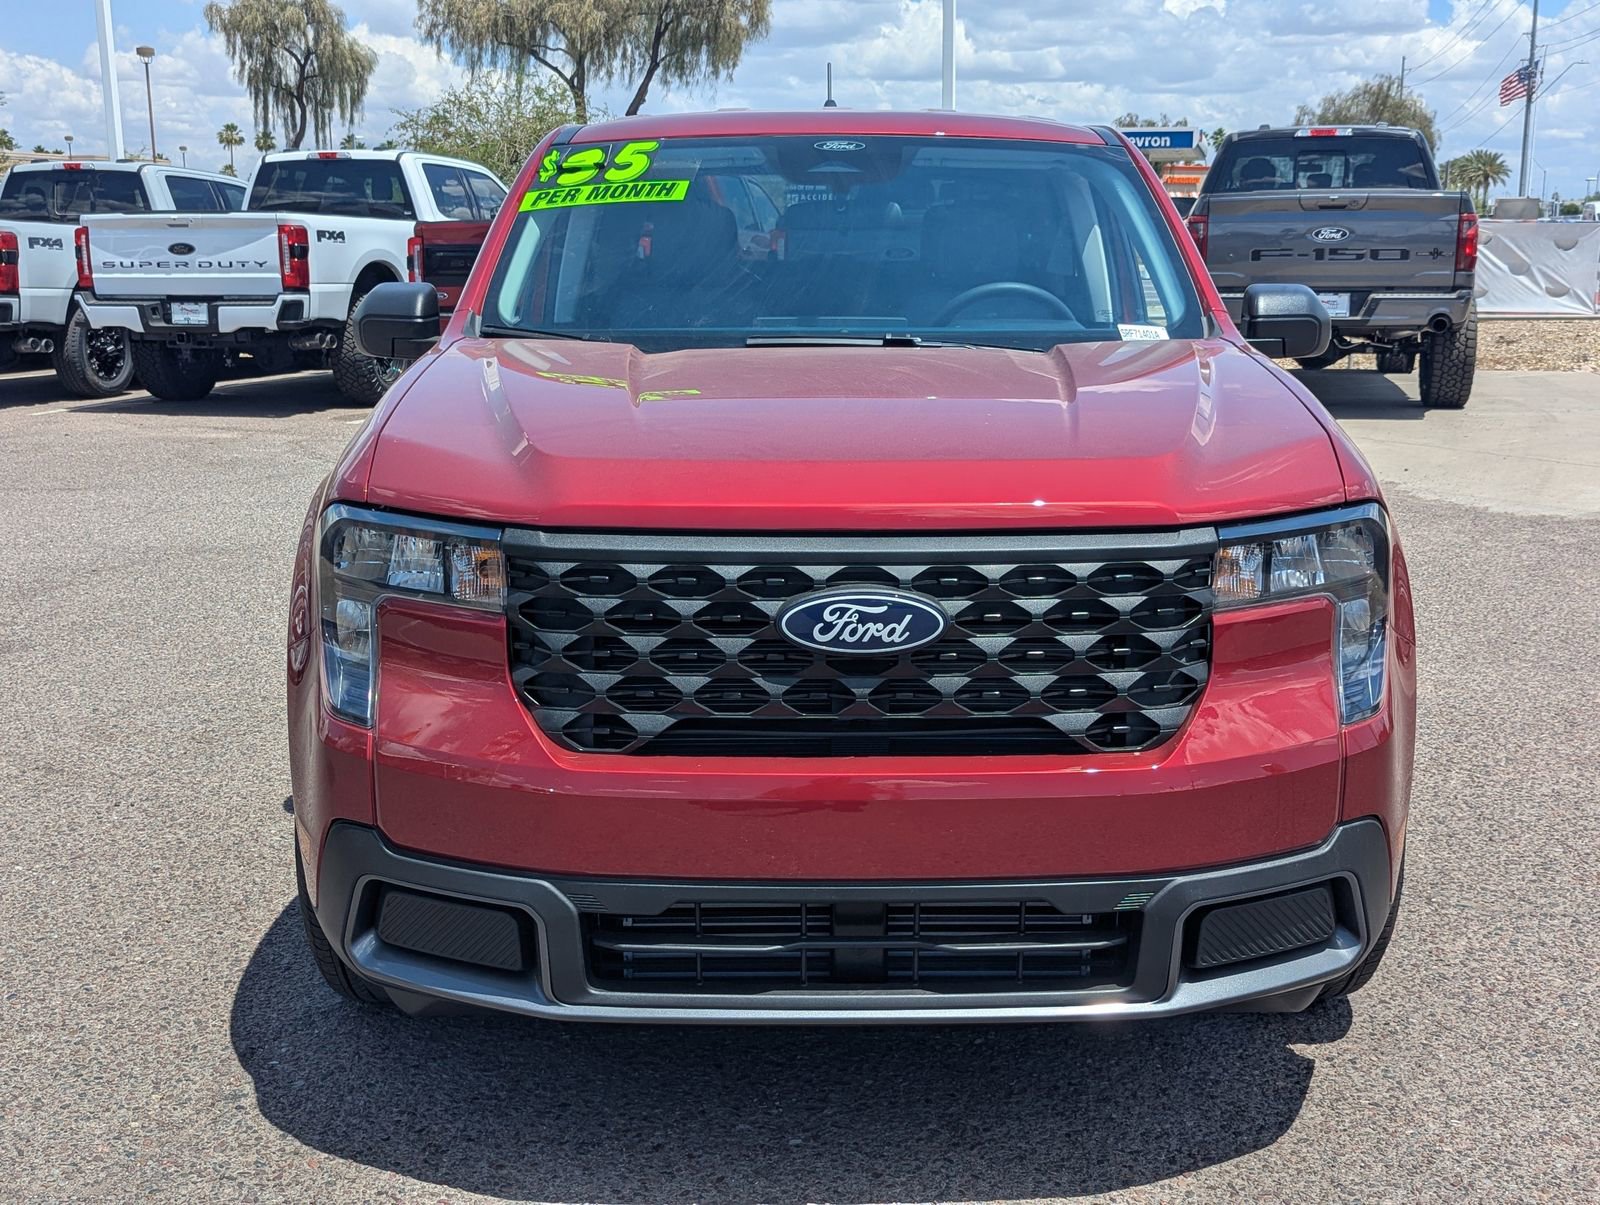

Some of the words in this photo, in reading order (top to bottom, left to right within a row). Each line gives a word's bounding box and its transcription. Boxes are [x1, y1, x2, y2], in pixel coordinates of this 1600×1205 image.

[530, 187, 582, 208] PER
[585, 182, 681, 202] MONTH
[28, 237, 63, 249] FX4
[316, 230, 346, 243] FX4
[1251, 248, 1411, 262] F-150
[102, 261, 190, 269] SUPER
[198, 261, 268, 269] DUTY
[812, 602, 914, 644] Ford
